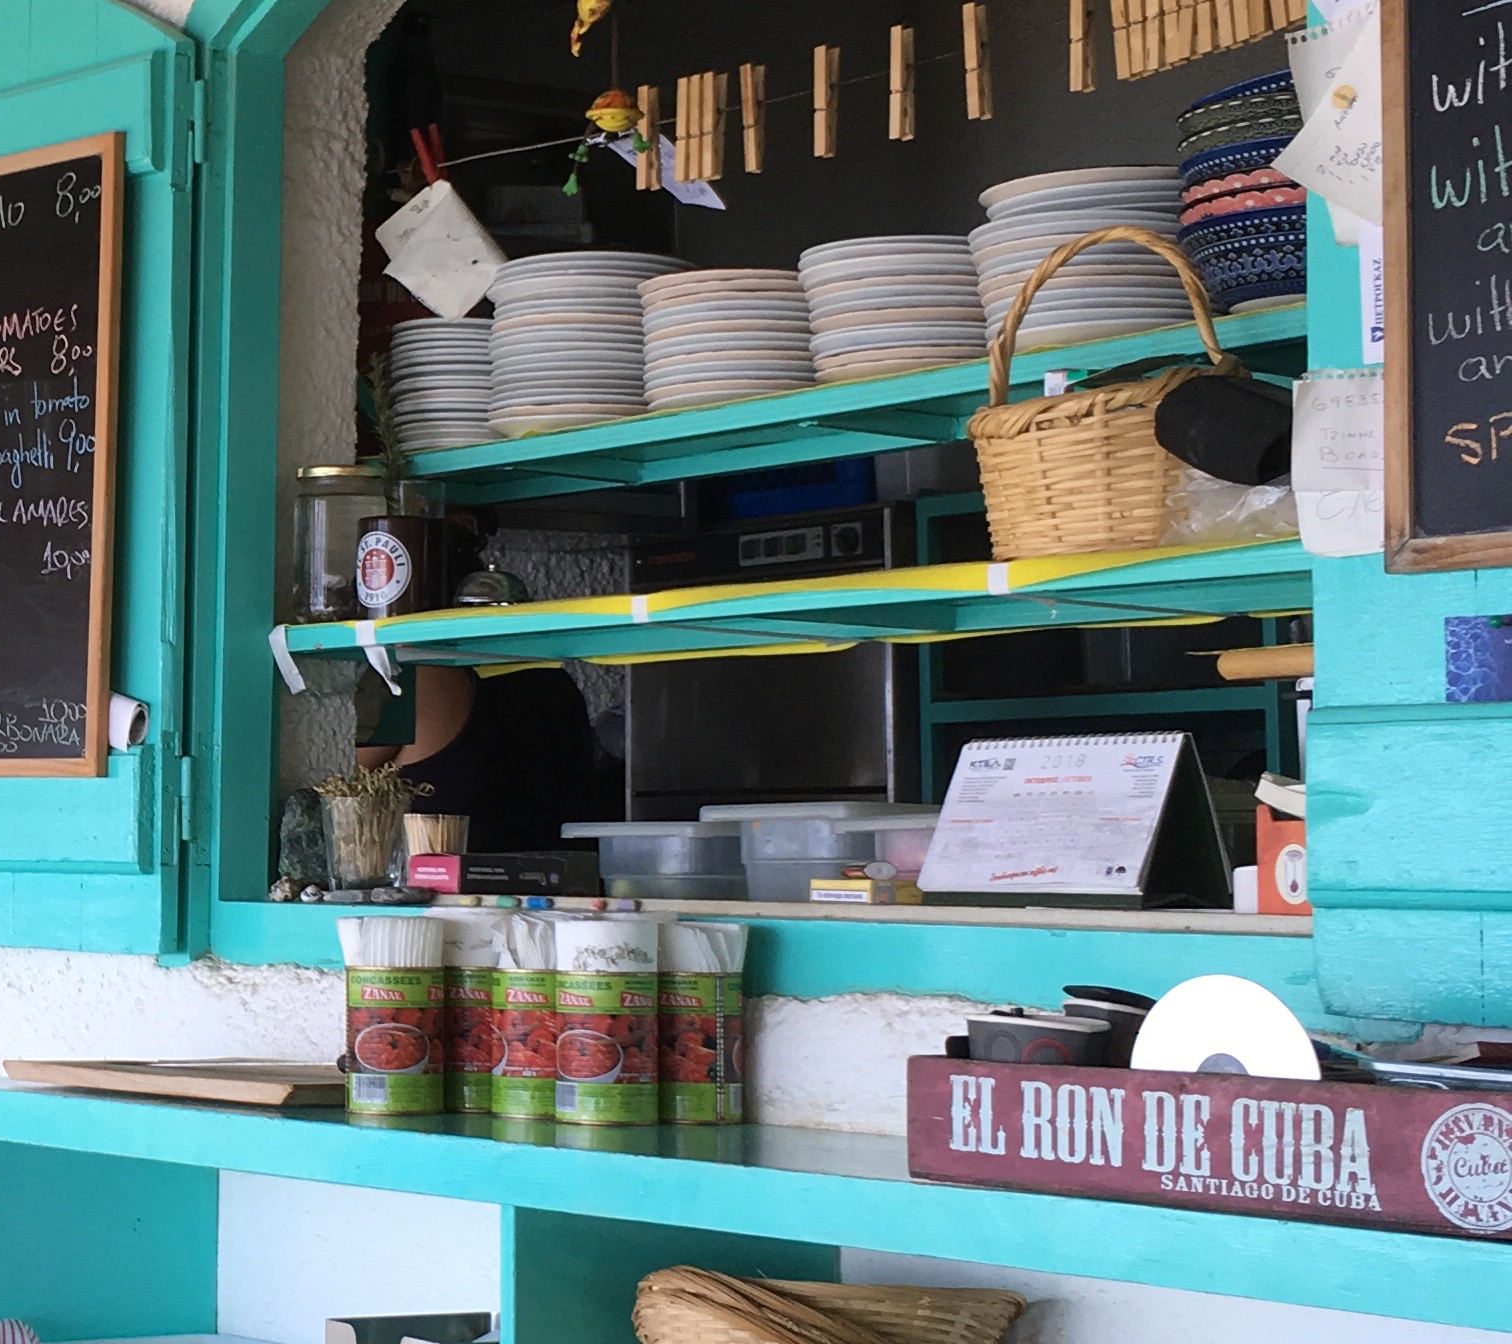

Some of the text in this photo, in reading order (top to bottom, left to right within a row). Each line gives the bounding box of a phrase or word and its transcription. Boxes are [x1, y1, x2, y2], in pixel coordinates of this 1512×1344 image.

[4, 408, 22, 427] in
[30, 376, 90, 419] tomato
[350, 974, 422, 987] CONCASSEES
[949, 1073, 1006, 1156] EL
[1019, 1079, 1126, 1168] RON
[1141, 1090, 1213, 1177] DE
[1230, 1097, 1376, 1196] CUBA
[1160, 1173, 1383, 1213] SANTIAGO DE CUBA
